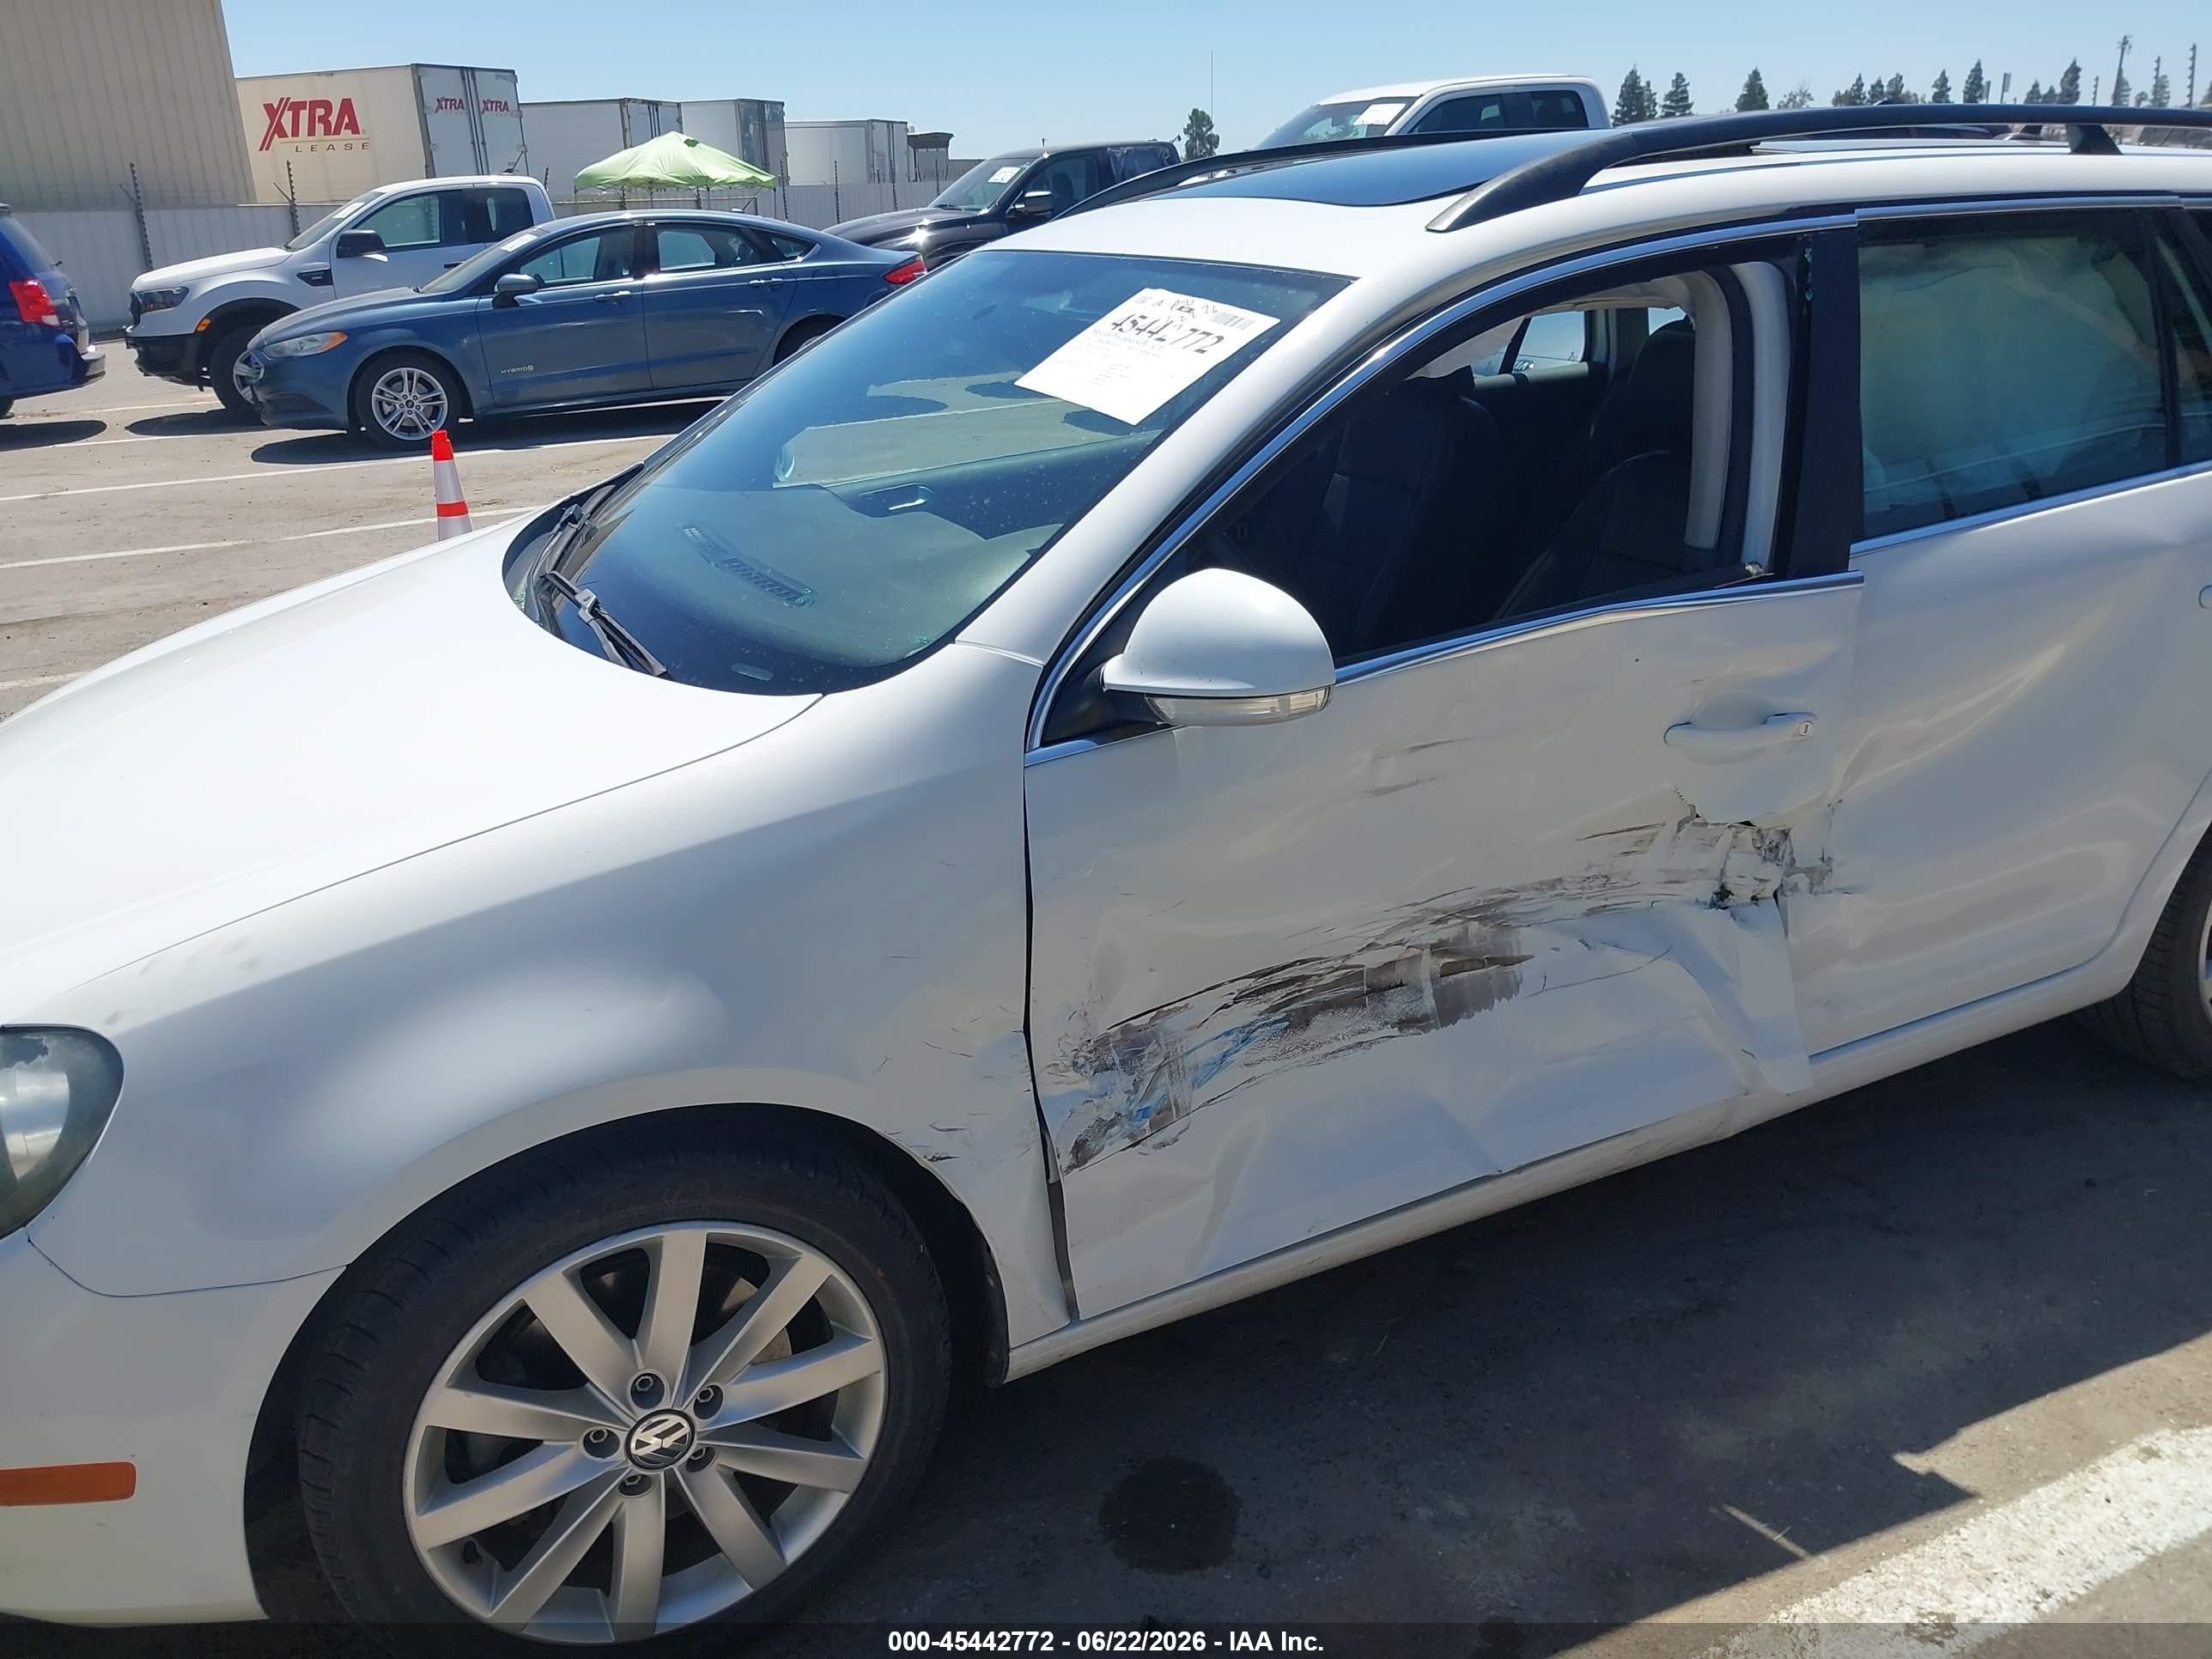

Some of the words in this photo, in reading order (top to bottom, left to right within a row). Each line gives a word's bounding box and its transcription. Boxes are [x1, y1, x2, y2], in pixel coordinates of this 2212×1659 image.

[434, 97, 465, 113] XTRA
[481, 99, 509, 115] XTRA
[258, 96, 361, 152] XTRA
[295, 142, 370, 153] LEASE
[501, 365, 528, 375] HYBRID
